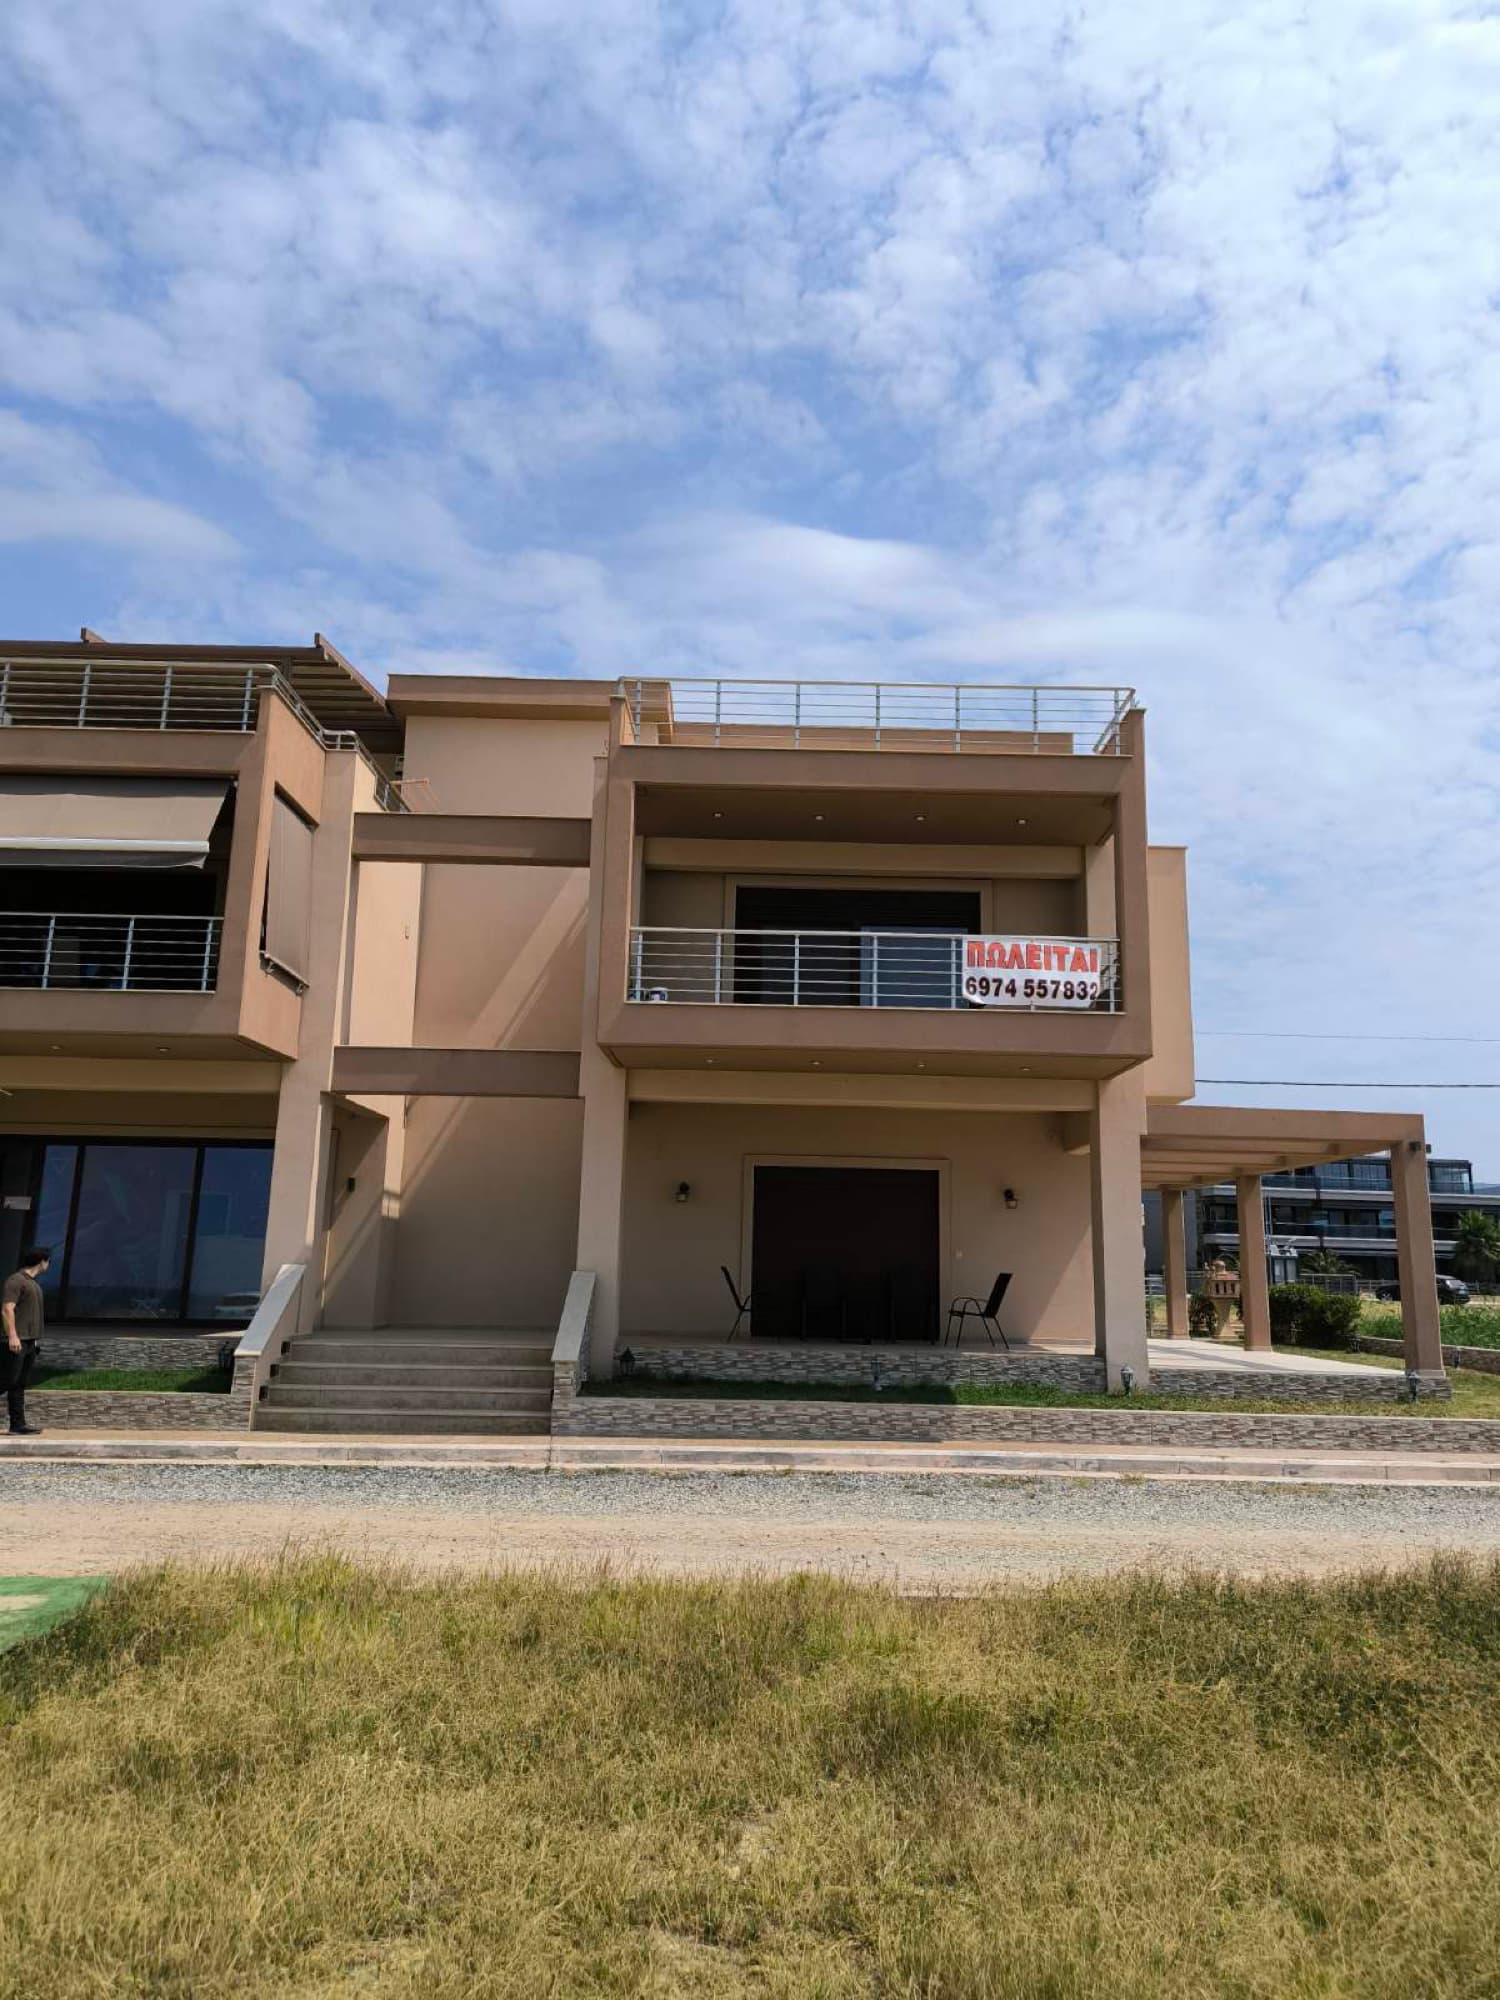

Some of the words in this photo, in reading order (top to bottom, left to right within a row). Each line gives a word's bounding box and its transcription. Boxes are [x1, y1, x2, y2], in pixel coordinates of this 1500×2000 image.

[967, 941, 1098, 973] ΠΩΛΕΙΤΑΙ
[966, 976, 1017, 998] 6974
[1023, 979, 1098, 1000] 557832
